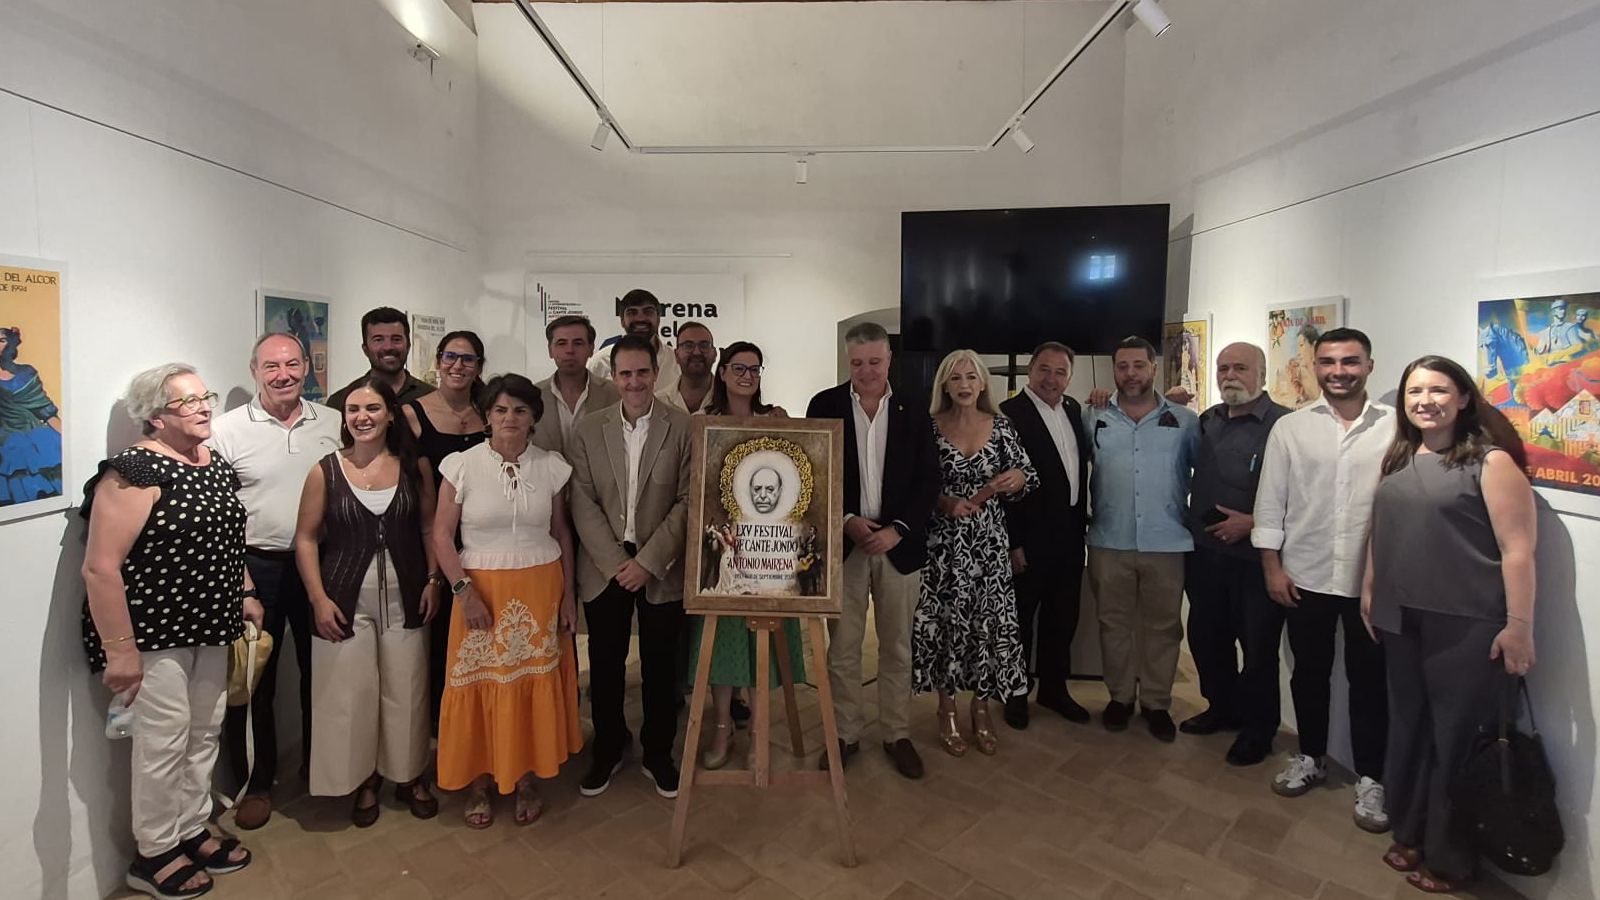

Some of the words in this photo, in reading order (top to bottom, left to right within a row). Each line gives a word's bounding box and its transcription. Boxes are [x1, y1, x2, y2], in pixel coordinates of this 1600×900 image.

[4, 272, 20, 282] DEL
[26, 274, 57, 285] ALCOR
[1535, 467, 1578, 484] ABRIL
[736, 524, 753, 537] LXV
[754, 525, 793, 538] FESTIVAL
[745, 539, 770, 553] CANTE
[771, 540, 799, 553] JONDO
[727, 557, 760, 570] ANTONIO
[761, 558, 794, 571] MAIRENA
